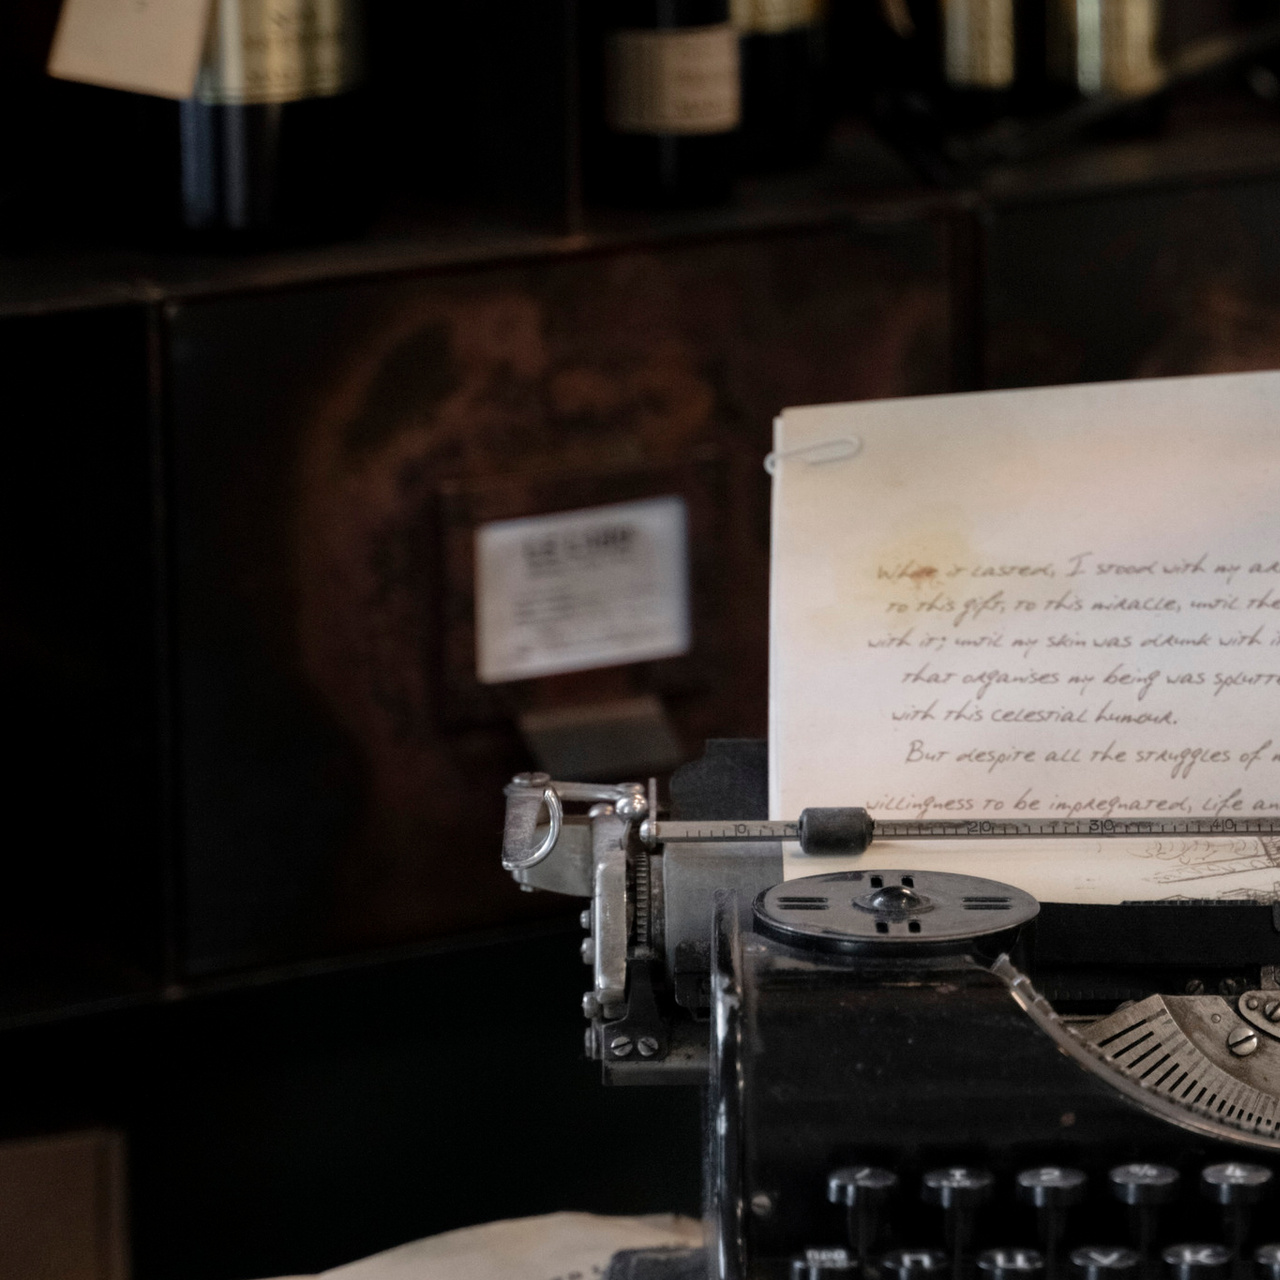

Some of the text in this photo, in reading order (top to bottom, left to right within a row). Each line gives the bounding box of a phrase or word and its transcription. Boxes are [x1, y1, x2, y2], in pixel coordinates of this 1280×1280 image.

[971, 565, 1056, 578] lasted,
[1066, 551, 1093, 578] I
[1096, 561, 1158, 576] stood
[1162, 553, 1208, 575] with
[1214, 564, 1241, 585] my
[887, 602, 909, 614] to
[916, 592, 955, 612] this
[955, 589, 1005, 628] gift,
[1014, 599, 1037, 612] to
[1044, 590, 1083, 612] this
[1090, 597, 1182, 613] miracle,
[1189, 597, 1239, 610] until
[867, 628, 913, 649] with
[919, 636, 947, 651] it;
[954, 635, 1003, 648] until
[1011, 638, 1039, 659] my
[1046, 633, 1087, 648] skin
[1092, 635, 1132, 649] was
[1139, 632, 1212, 648] drunk
[1218, 625, 1265, 647] with
[901, 663, 957, 684] that
[961, 669, 1060, 701] organises
[1067, 675, 1095, 696] my
[1102, 662, 1162, 702] being
[1166, 672, 1206, 685] was
[891, 700, 937, 722] with
[943, 700, 984, 722] this
[990, 708, 1088, 724] celestial
[904, 739, 949, 764] But
[955, 748, 1036, 774] despite
[1044, 748, 1081, 763] all
[1089, 740, 1127, 763] the
[1135, 747, 1231, 780] struggles
[1237, 738, 1273, 773] of
[982, 798, 1005, 811] to
[1012, 787, 1041, 811] be
[1201, 787, 1244, 816] life
